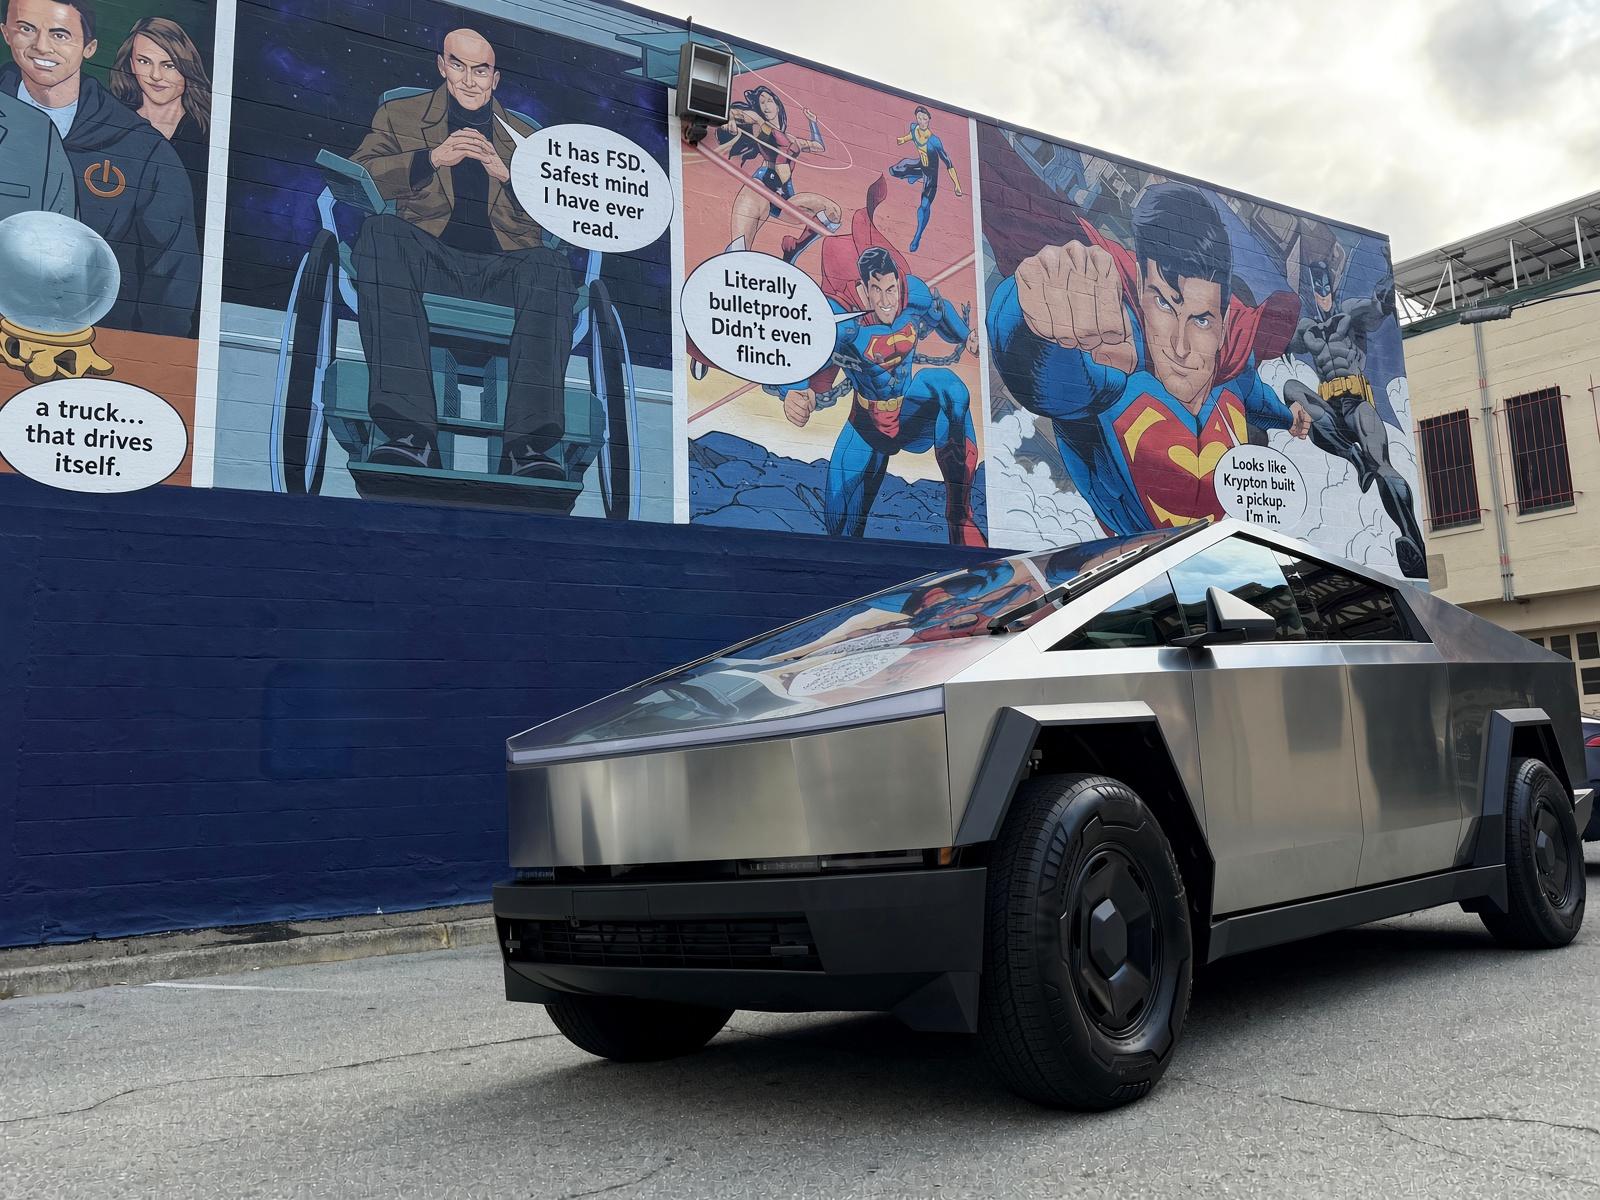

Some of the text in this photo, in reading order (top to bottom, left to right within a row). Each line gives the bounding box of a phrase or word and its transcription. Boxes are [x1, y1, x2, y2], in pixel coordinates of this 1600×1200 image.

[548, 138, 646, 174] It has FSD.
[540, 161, 649, 198] Safest mind
[544, 186, 645, 220] I have ever
[572, 219, 619, 240] read.
[724, 269, 797, 300] Literally
[709, 291, 812, 322] bulletproof.
[711, 317, 811, 346] Didn't even
[736, 344, 791, 368] flinch.
[35, 400, 144, 425] a truck...
[25, 423, 153, 452] that drives
[55, 451, 121, 477] itself.
[1232, 456, 1287, 474] Looks like
[1223, 472, 1296, 492] Krypton built
[1236, 491, 1287, 511] a pickup.
[1246, 509, 1281, 525] I'm in.
